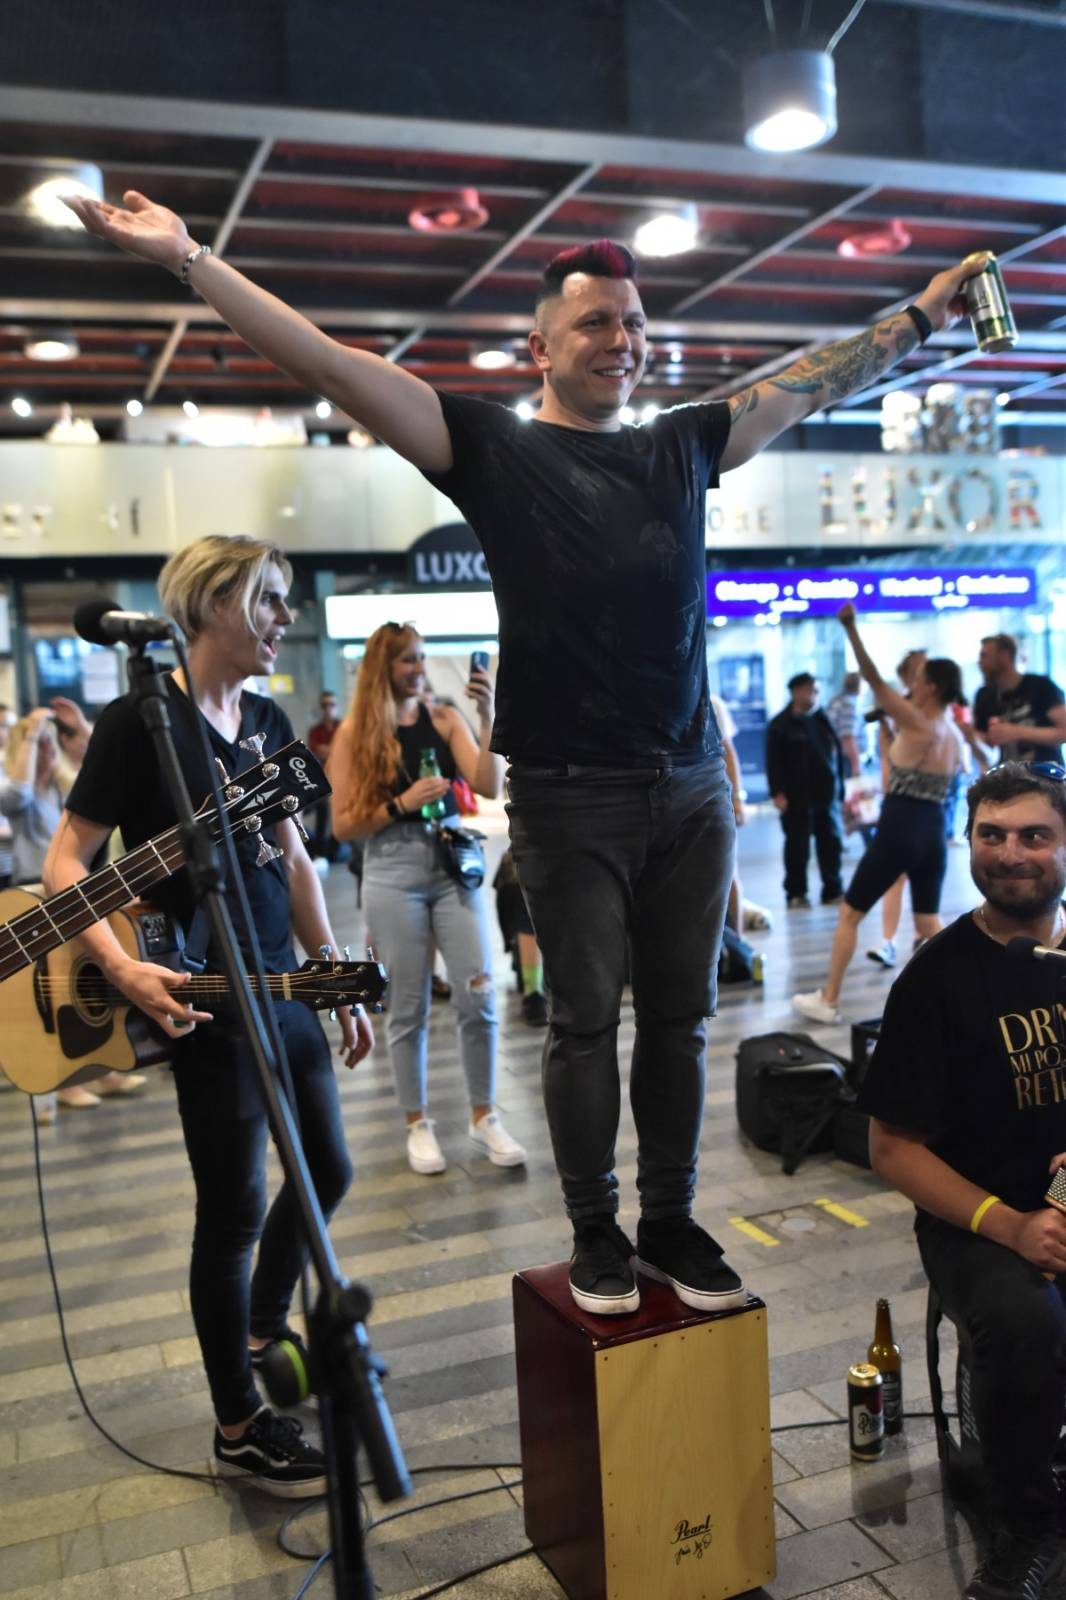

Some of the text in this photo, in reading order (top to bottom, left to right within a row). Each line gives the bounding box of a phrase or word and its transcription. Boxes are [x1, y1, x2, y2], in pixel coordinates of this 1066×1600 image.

[819, 463, 1042, 535] LUXOR
[288, 756, 318, 791] Cort
[670, 1514, 711, 1545] Pearl
